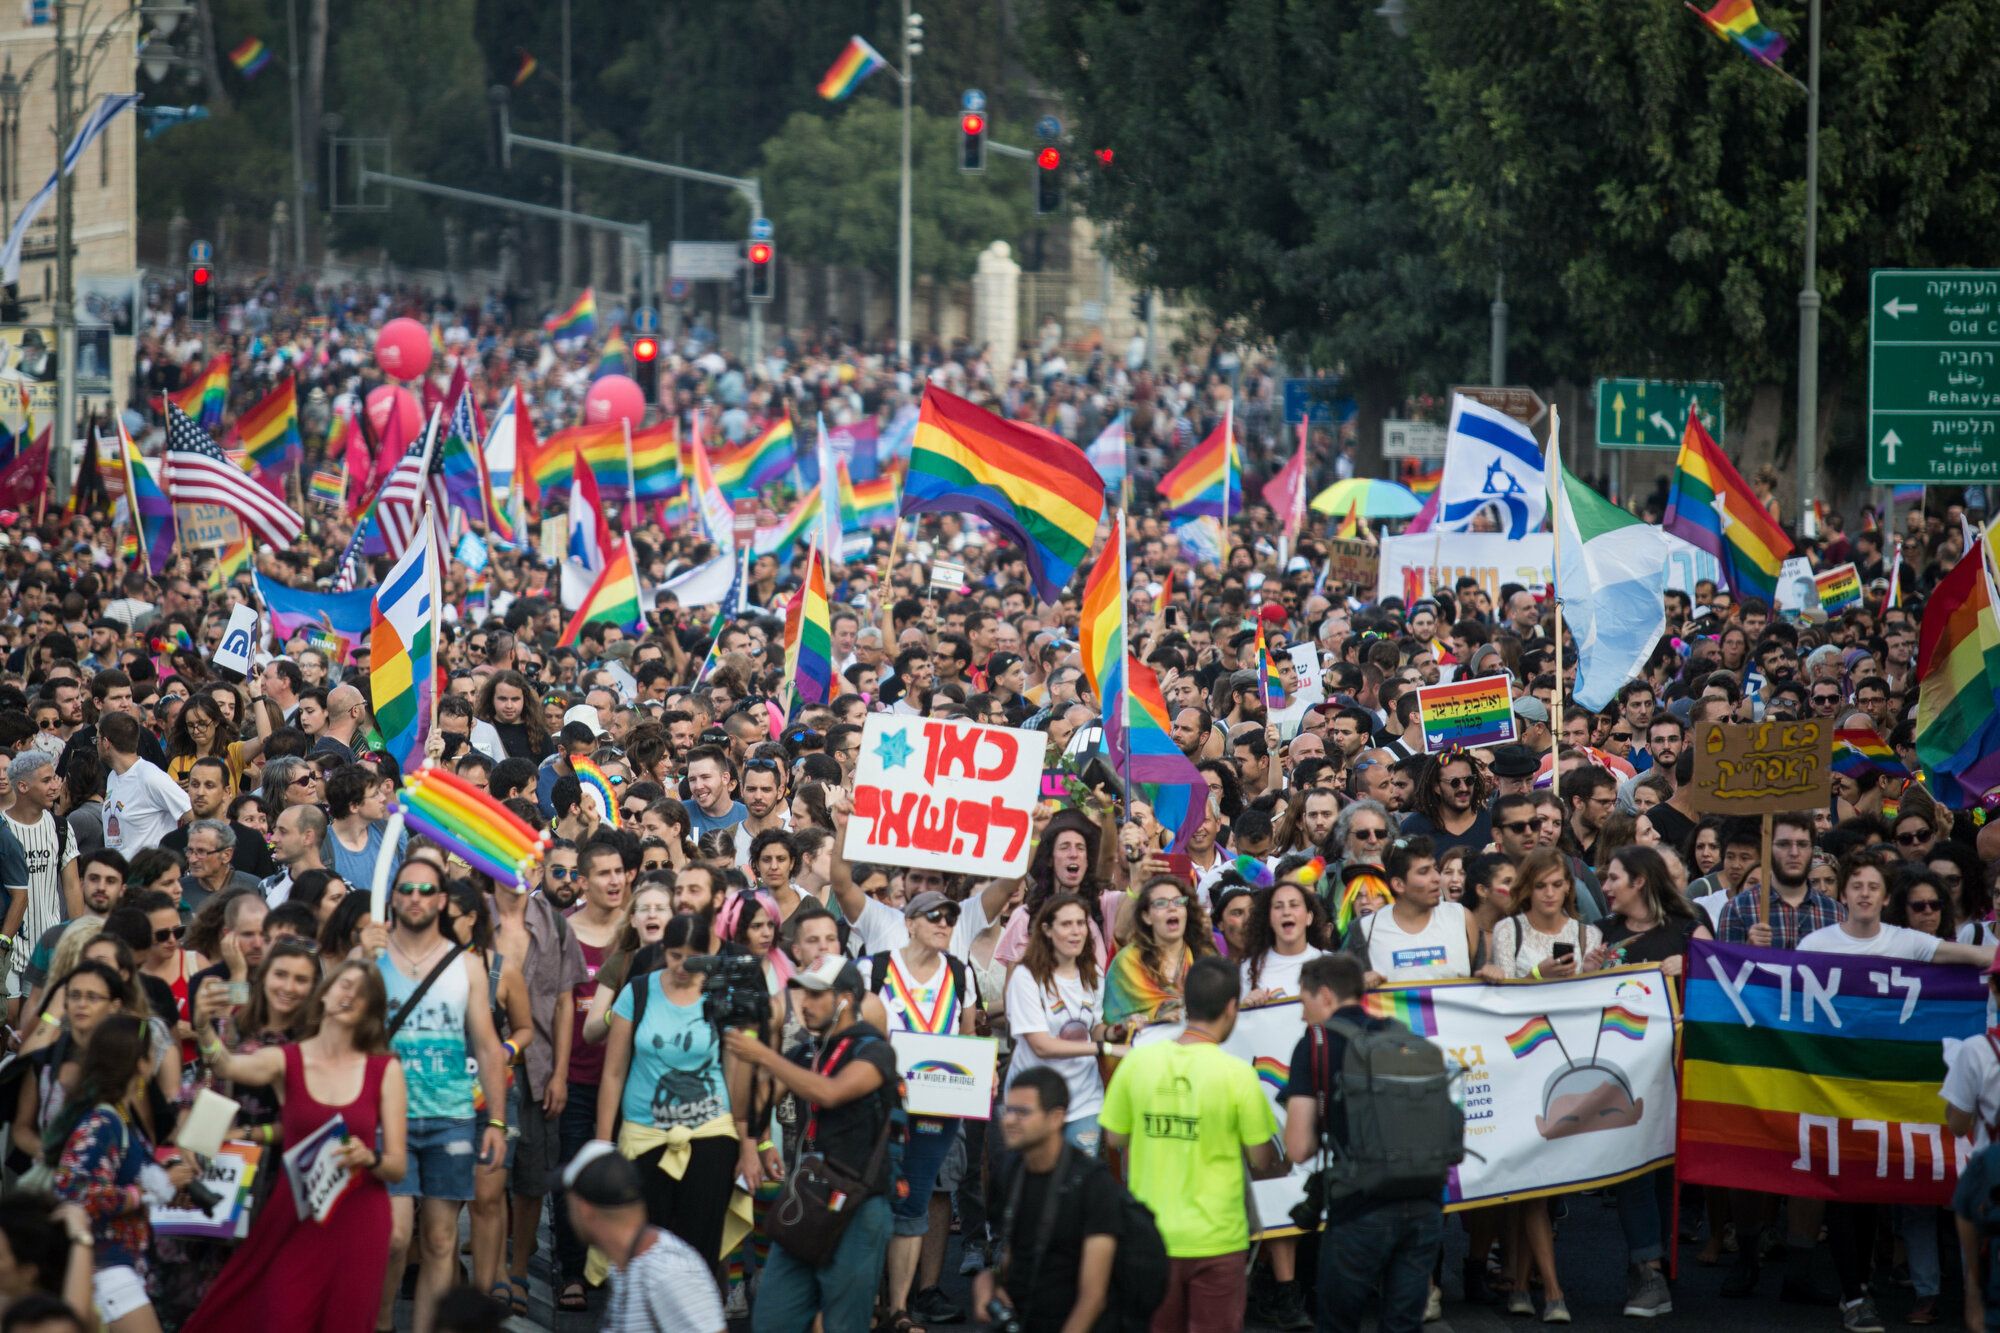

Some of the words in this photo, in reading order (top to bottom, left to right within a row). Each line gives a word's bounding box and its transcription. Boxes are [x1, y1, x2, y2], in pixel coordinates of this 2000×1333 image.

[1926, 281, 1997, 298] העתיקה
[1948, 320, 1978, 334] Old
[1987, 320, 2000, 334] C
[1939, 351, 1994, 365] רחביה
[1928, 390, 2000, 408] Rehavya
[1932, 418, 1995, 435] תלפיות
[1929, 460, 1998, 477] Talpiyot
[923, 722, 1019, 787] כאן
[854, 784, 1029, 863] להשאר
[28, 864, 47, 874] GHT
[1706, 954, 1842, 1028] ארץ
[1868, 966, 1922, 1025] לי
[924, 1073, 946, 1082] WIDER
[950, 1075, 975, 1086] BRIDGE
[1466, 1071, 1489, 1081] ride
[1467, 1084, 1491, 1095] מצע
[1467, 1098, 1493, 1107] ance
[1467, 1124, 1497, 1136] ירושל
